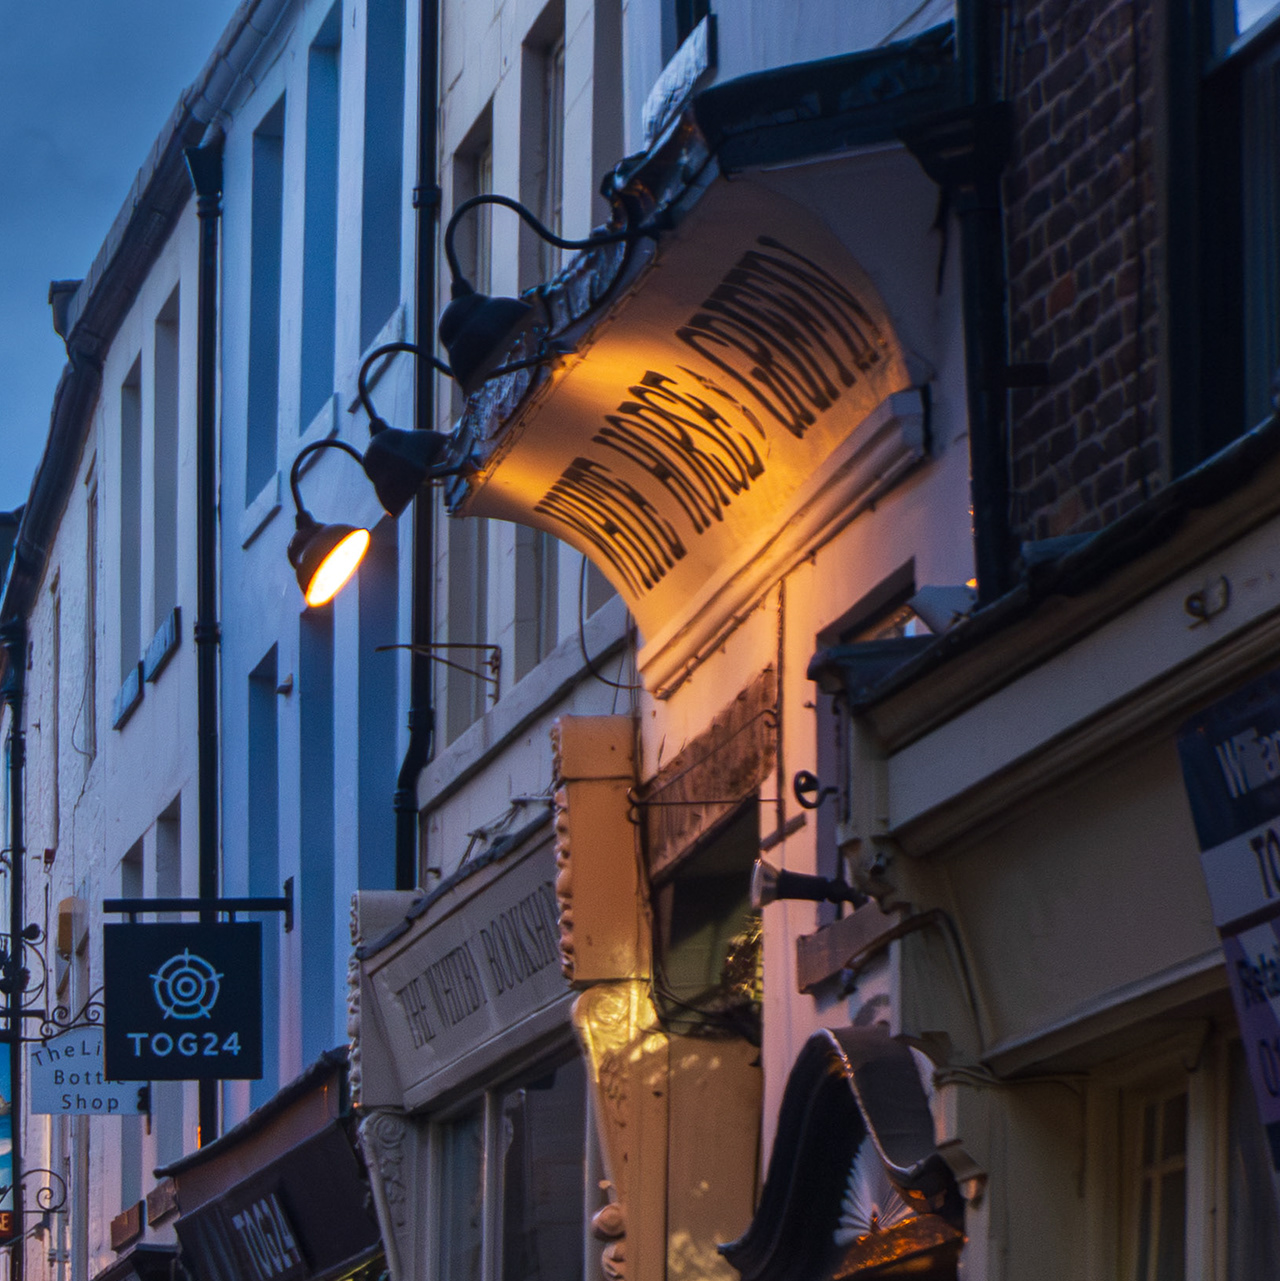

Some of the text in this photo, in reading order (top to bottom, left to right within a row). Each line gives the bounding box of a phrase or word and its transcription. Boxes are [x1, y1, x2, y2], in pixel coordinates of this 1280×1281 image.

[591, 370, 766, 535] HORSE
[533, 456, 688, 601] WHITE
[396, 880, 561, 1050] THE WHITBY BOOKSHO
[31, 1043, 75, 1067] The
[126, 1031, 242, 1057] TOG24
[54, 1069, 125, 1085] Bott
[61, 1093, 119, 1110] Shop
[232, 1192, 302, 1281] TOG24
